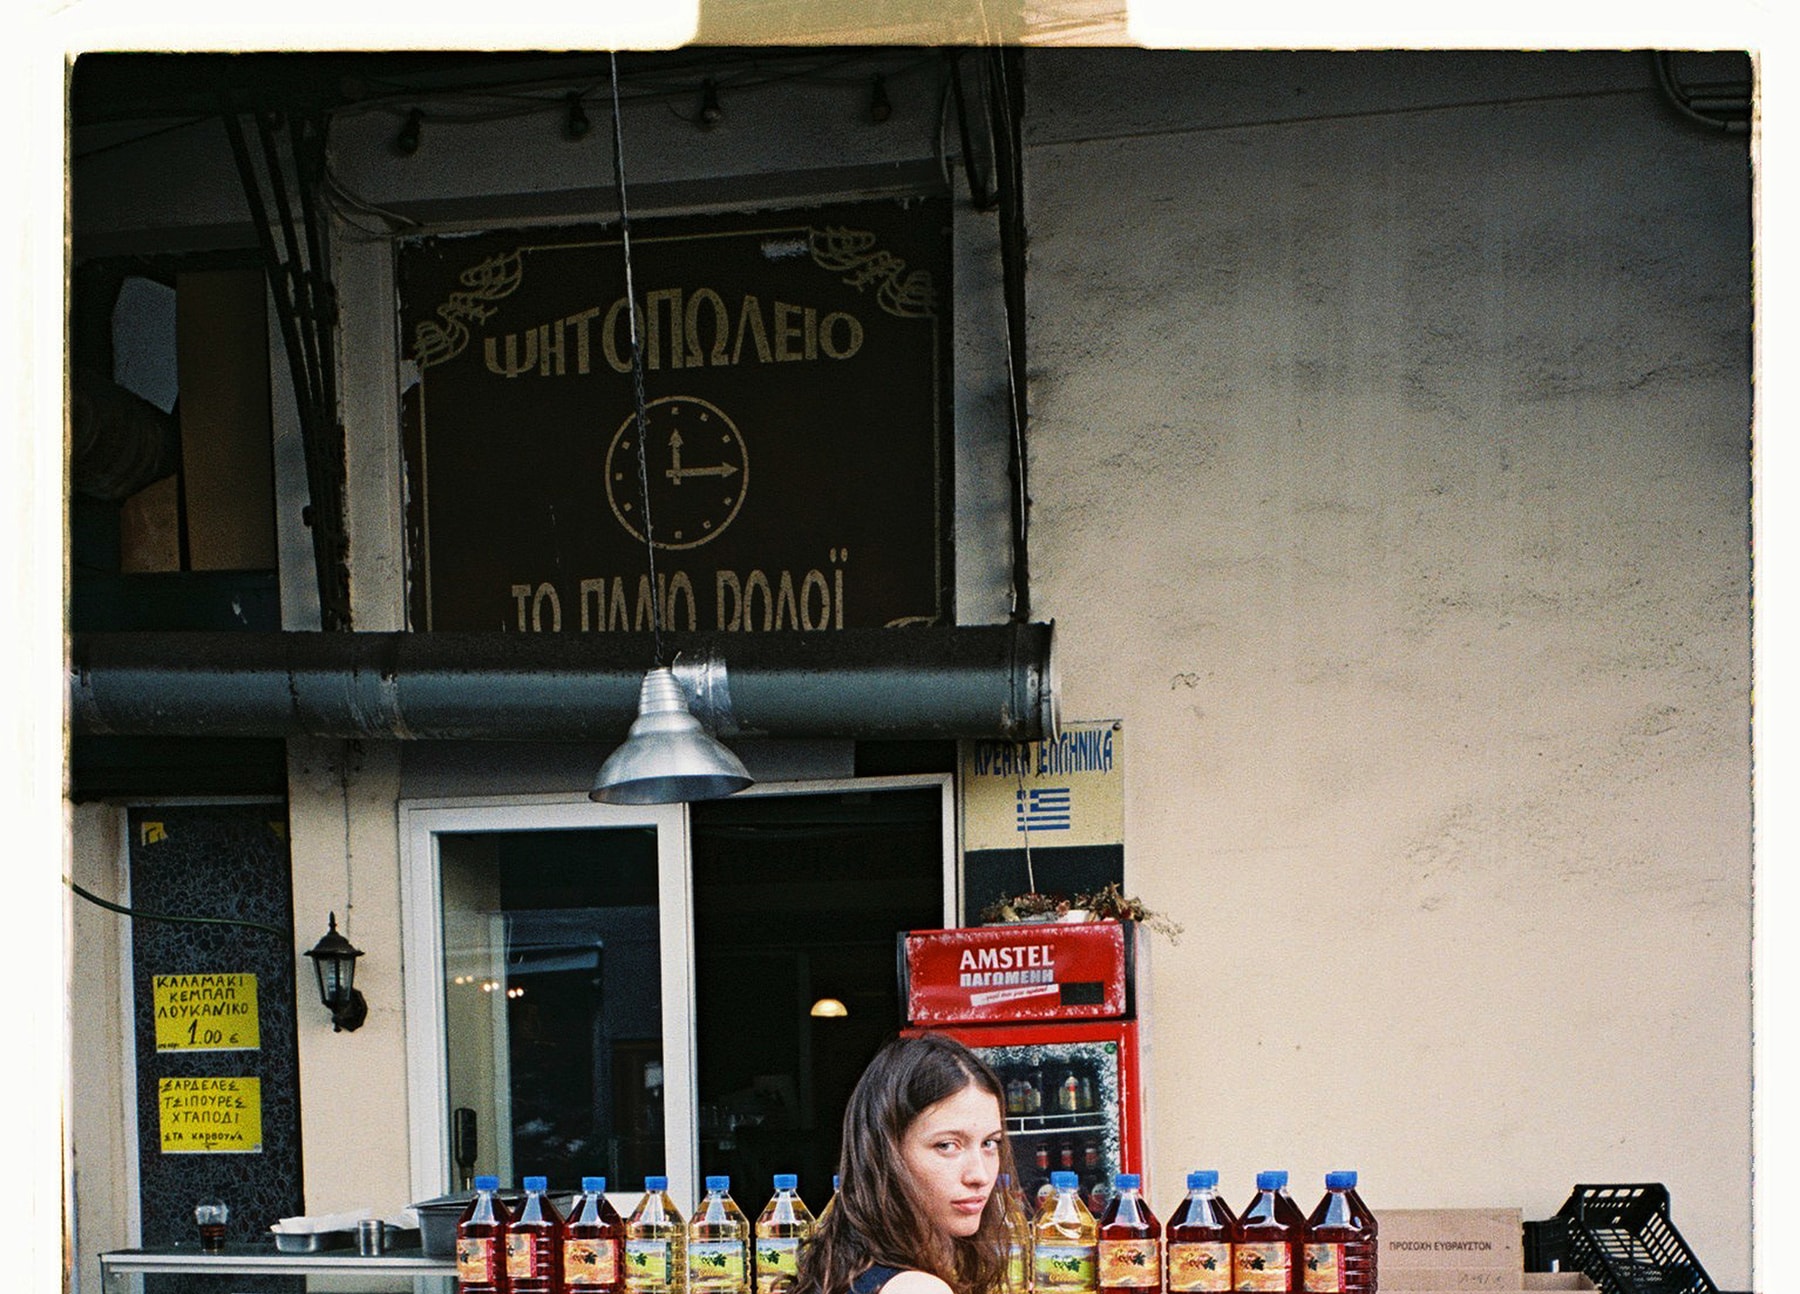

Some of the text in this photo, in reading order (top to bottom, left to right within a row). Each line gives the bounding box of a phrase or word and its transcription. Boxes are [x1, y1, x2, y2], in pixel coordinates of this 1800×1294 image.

[484, 287, 864, 378] ΨΗΤΟΠΩΛΕΙΟ
[959, 945, 1055, 970] AMSTEL
[157, 976, 243, 988] ΚΑΛΑΜΑΚΙ
[960, 969, 1054, 987] ΠΑΓΩΜΕΝΗ
[169, 988, 236, 1003] ΚΕΜΠΑΠ
[158, 1002, 249, 1019] ΛΟΥΚΑΝΙΚΟ
[187, 1019, 223, 1045] 1.00
[160, 1080, 240, 1093] ΣΑΡΔΕΛΕΣ
[164, 1095, 247, 1109] ΤΣΙΠΟΥΡΕΣ
[172, 1111, 239, 1124] ΧΤΑΠΟΔΙ
[164, 1131, 184, 1142] ΣΤΑ
[1389, 1241, 1492, 1251] ΠΡΟΣΟΧΗ ΕΥΘΡΑΥΣΤΟΝ
